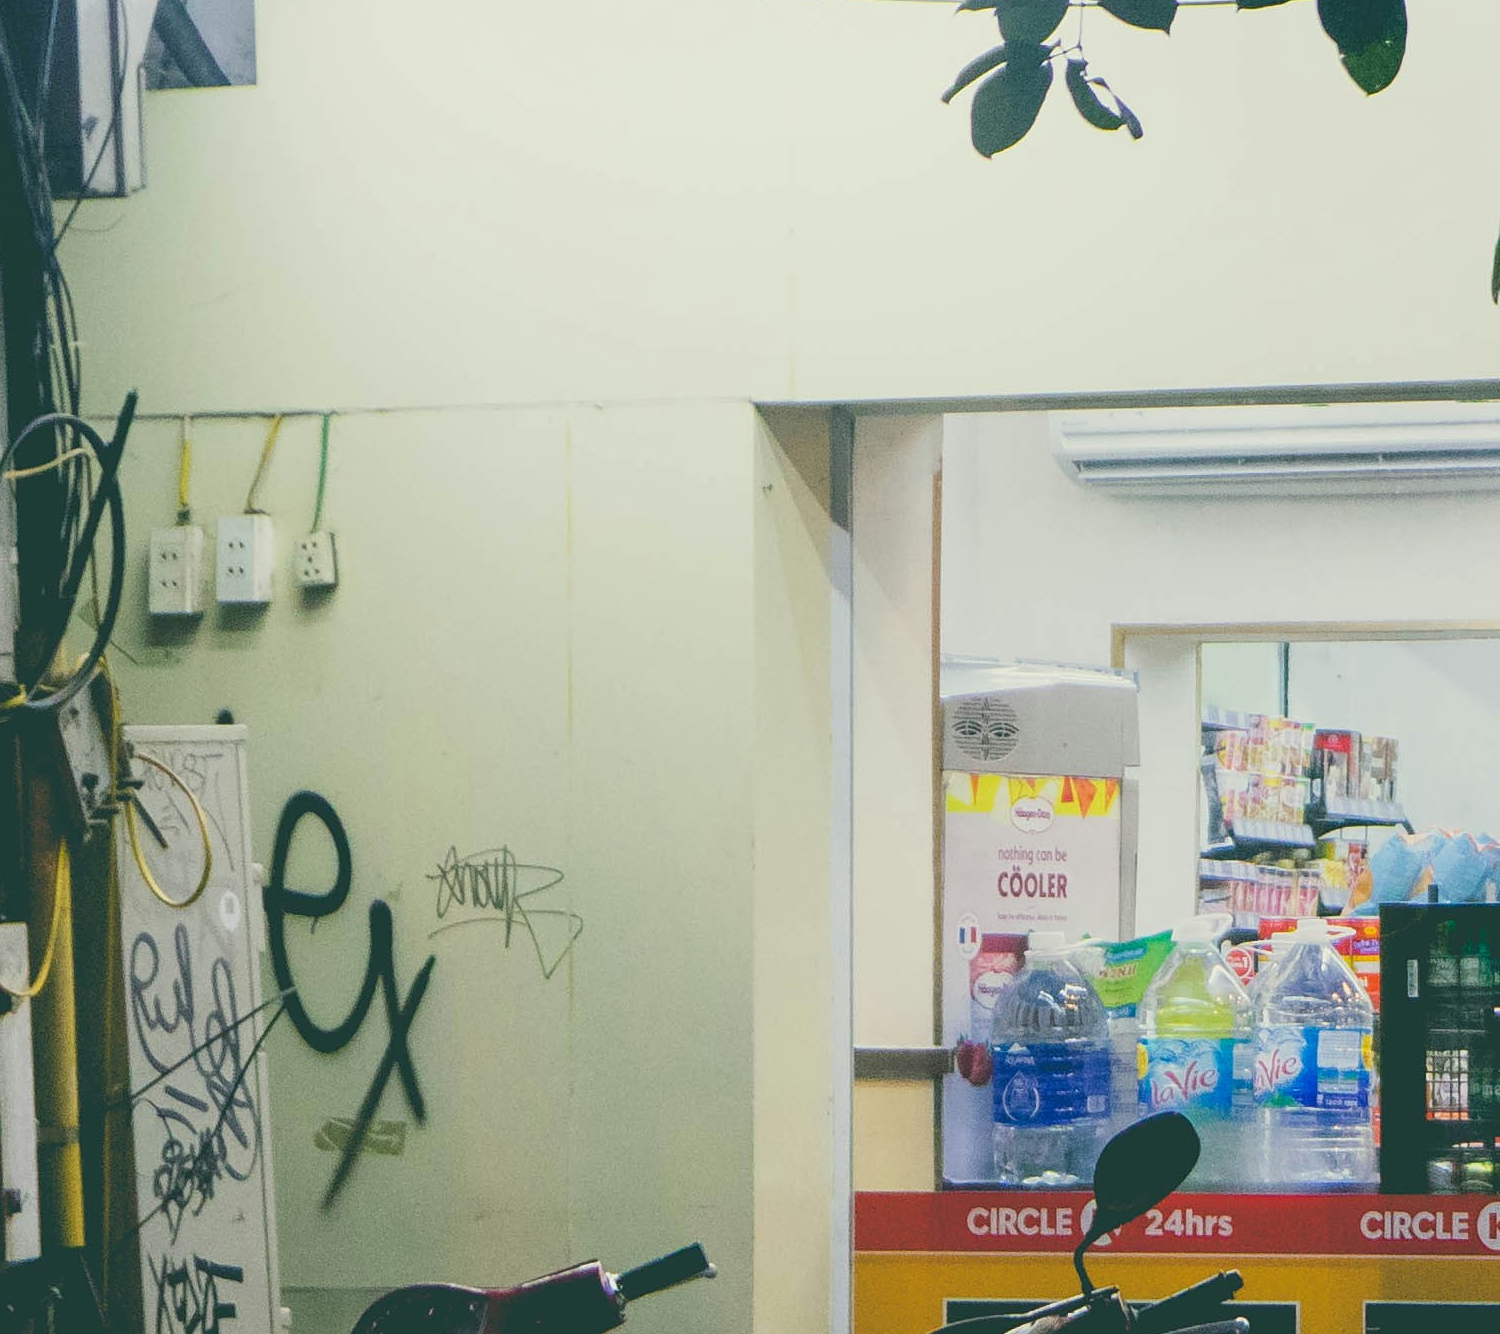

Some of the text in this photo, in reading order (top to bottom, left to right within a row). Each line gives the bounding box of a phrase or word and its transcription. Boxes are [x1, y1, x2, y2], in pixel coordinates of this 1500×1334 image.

[998, 845, 1067, 865] nothing can be
[966, 1207, 1073, 1236] CIRCLE
[1144, 1209, 1234, 1237] 24hrs
[1360, 1211, 1469, 1240] CIRCLE
